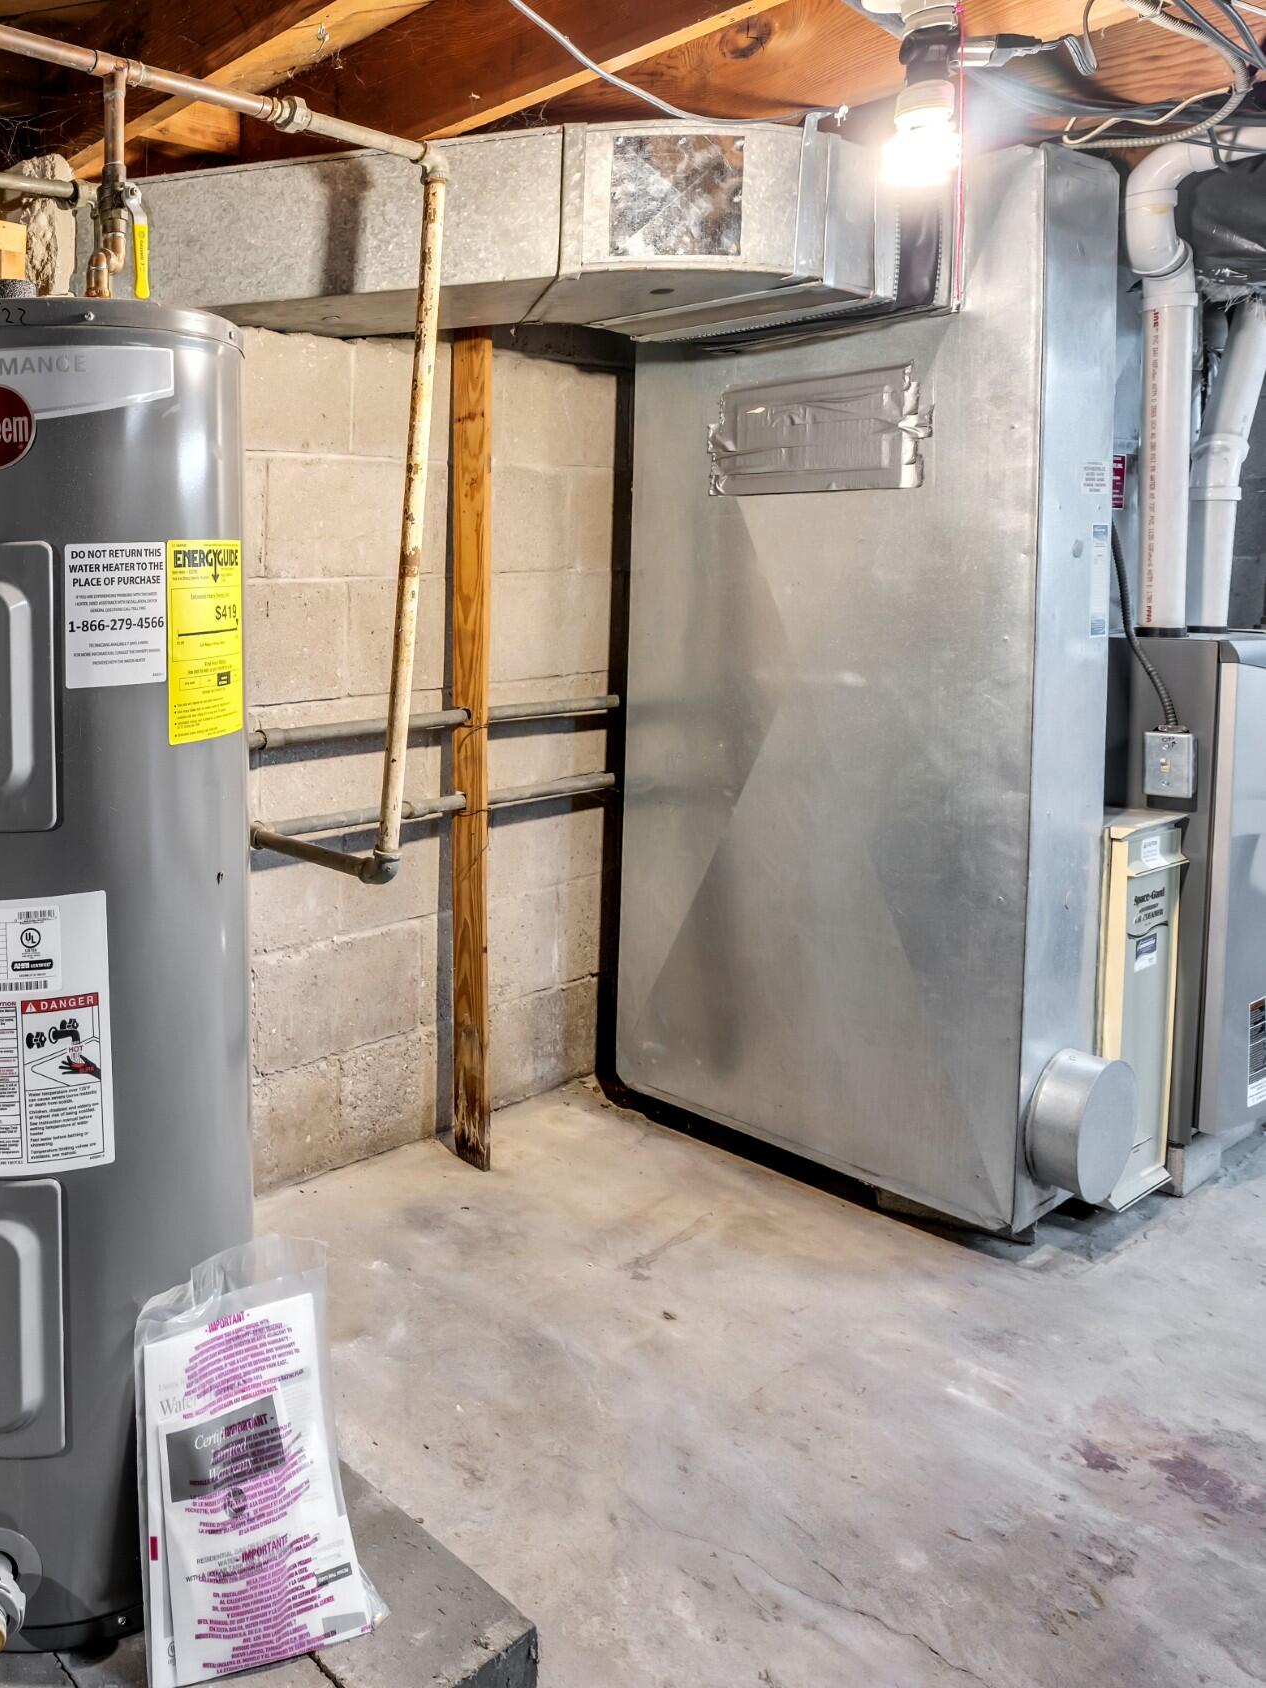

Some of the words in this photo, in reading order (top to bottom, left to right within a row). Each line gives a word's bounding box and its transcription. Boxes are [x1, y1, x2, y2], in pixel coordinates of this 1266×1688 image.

[71, 550, 85, 559] DO
[87, 550, 107, 558] NOT
[109, 549, 142, 558] RETURN
[144, 548, 162, 557] THIS
[174, 549, 238, 568] ENERGYGUIDE
[69, 563, 100, 573] WATER
[102, 562, 134, 572] HEATER
[136, 562, 147, 571] TO
[148, 561, 164, 570] THE
[72, 577, 102, 587] PLACE
[104, 577, 115, 586] OF
[118, 575, 161, 585] PURCHASE
[215, 603, 236, 620] $419
[68, 616, 164, 633] 1-866-279-4566
[25, 932, 36, 943] UL
[40, 995, 94, 1010] DANGER
[208, 1310, 245, 1333] IMPORTANT
[241, 1533, 288, 1563] IMPORTANTE
